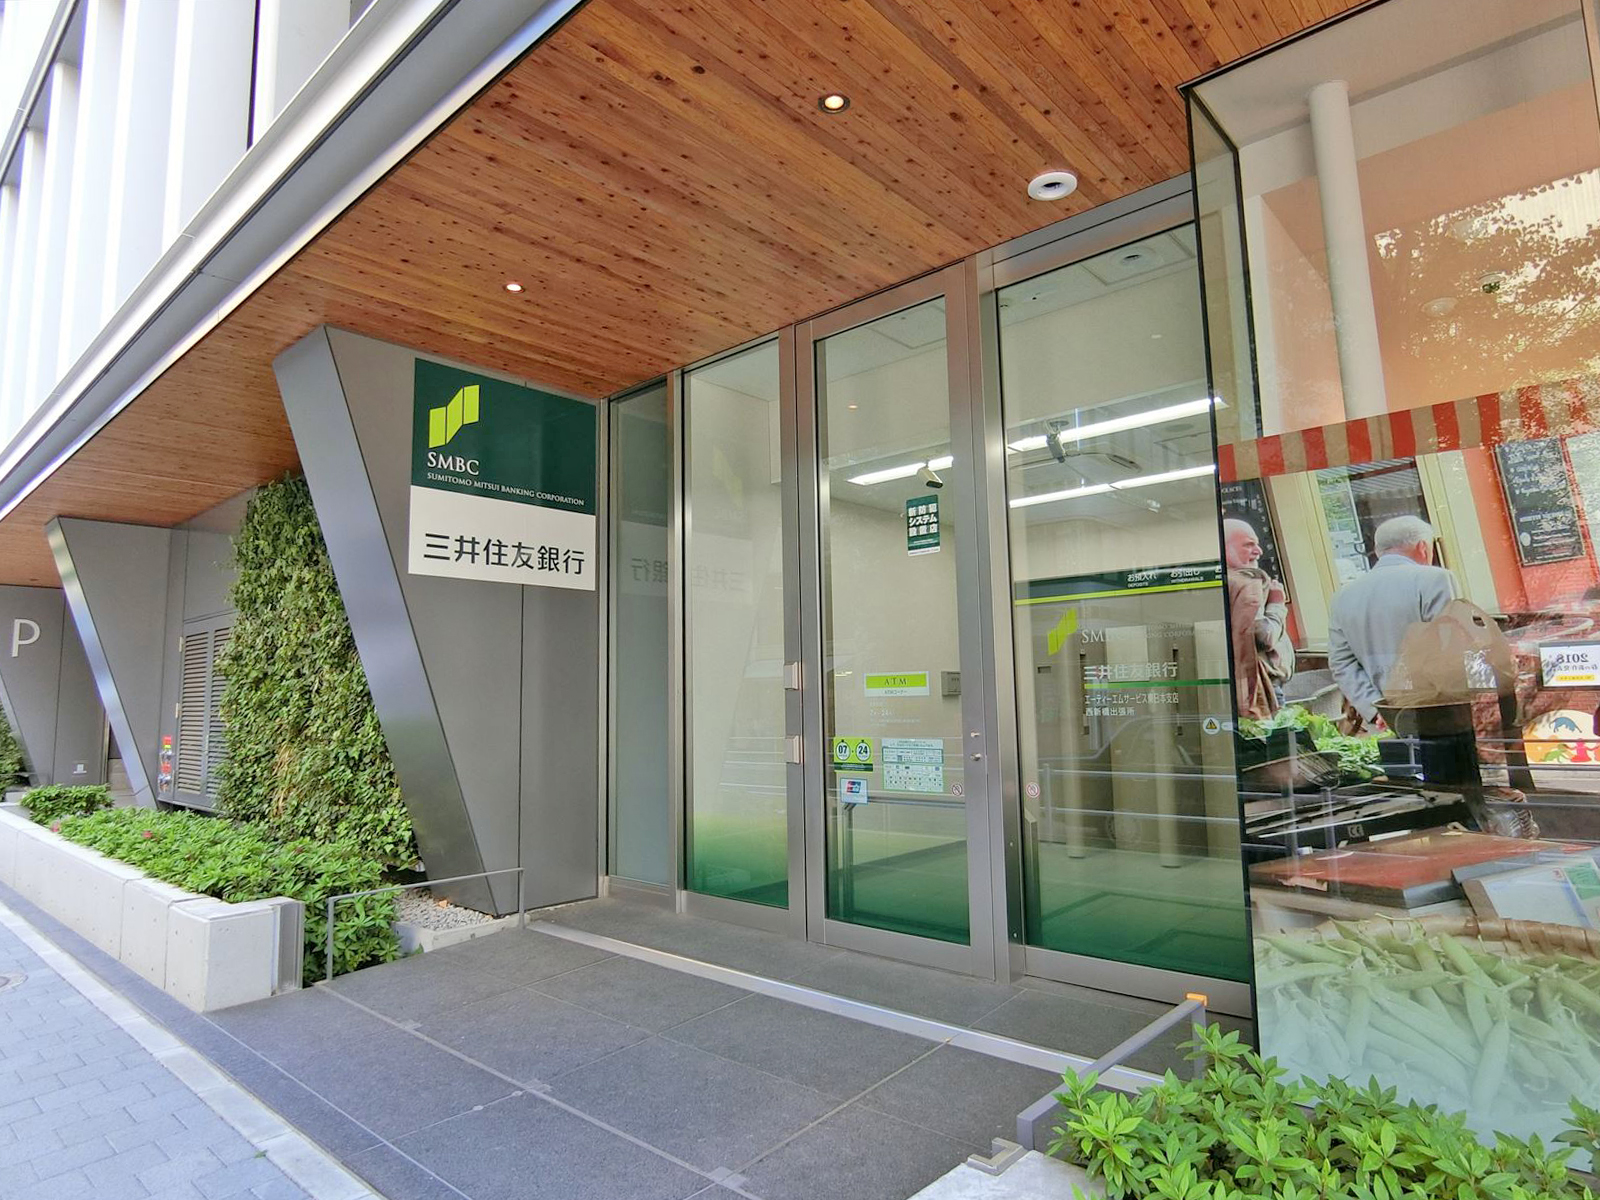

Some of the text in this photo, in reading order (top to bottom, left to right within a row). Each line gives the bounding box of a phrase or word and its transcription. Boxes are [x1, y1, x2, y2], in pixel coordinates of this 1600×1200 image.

[427, 451, 480, 476] SMBC
[427, 472, 585, 506] SUMITOMO MITSUI BANKING CORPORATION
[909, 513, 938, 527] システム
[423, 533, 586, 575] 三井住友銀行
[11, 618, 41, 658] P
[884, 677, 907, 686] ATM
[1084, 661, 1178, 680] 三井住友銀行
[838, 745, 868, 755] 07 24
